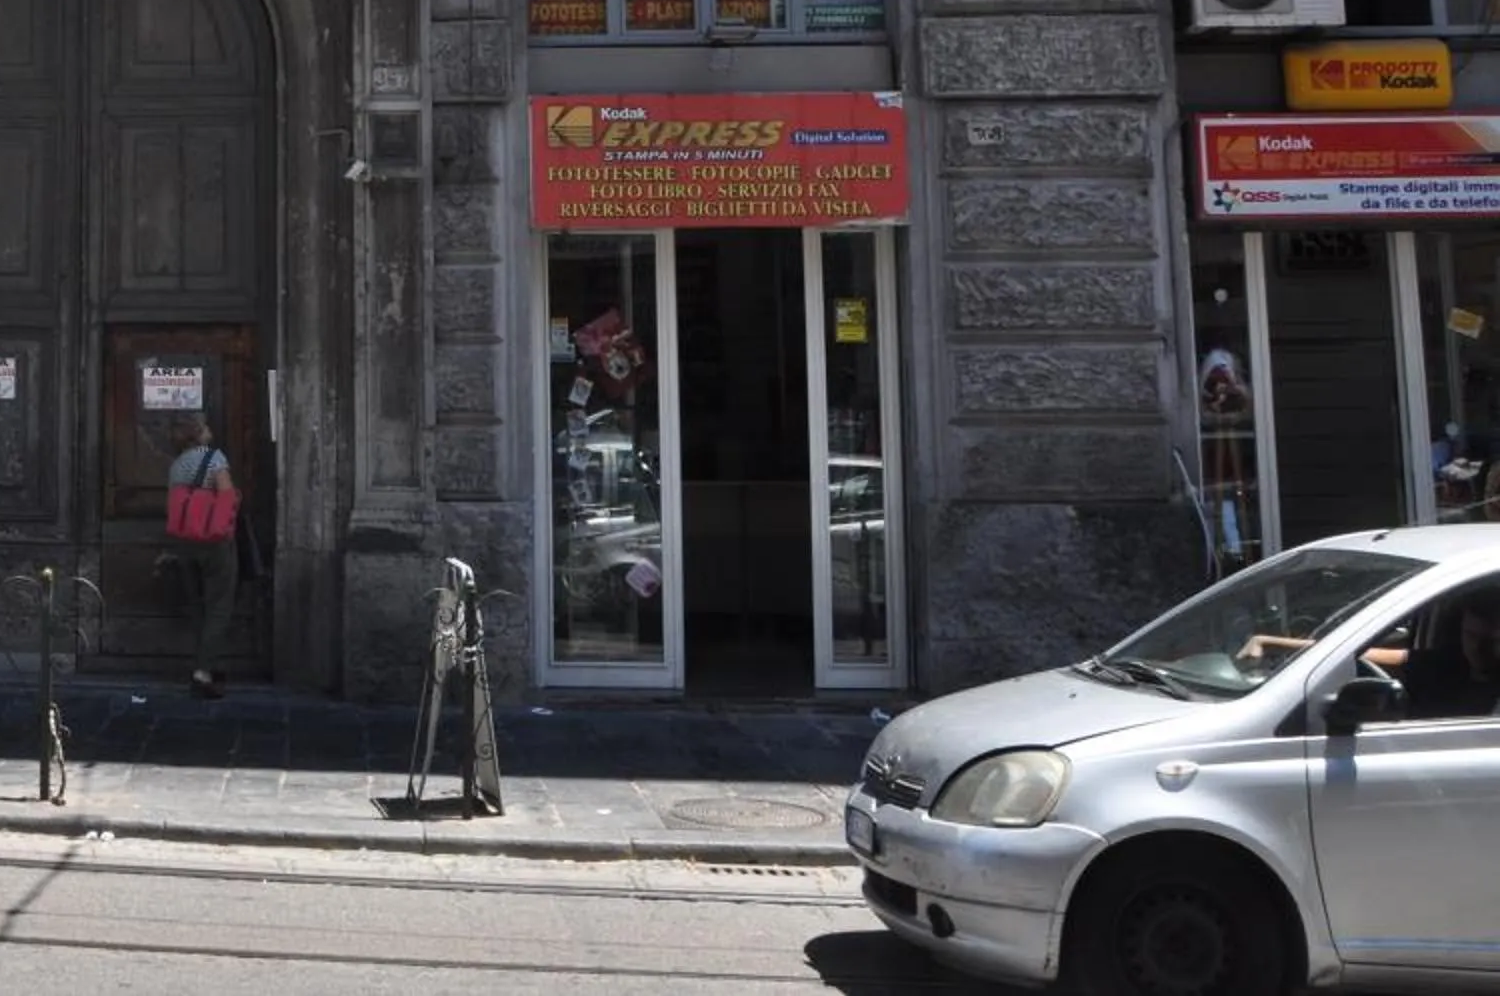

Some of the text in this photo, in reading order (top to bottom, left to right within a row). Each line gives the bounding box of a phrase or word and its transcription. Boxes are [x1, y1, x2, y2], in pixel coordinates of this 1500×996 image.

[1349, 60, 1439, 75] PRODOTTI
[1380, 74, 1440, 89] Kodak
[601, 107, 647, 120] Kodak
[602, 120, 885, 147] EXPRESS Digital Solution
[1258, 134, 1313, 151] Kodak
[603, 151, 669, 161] STAMPA
[672, 150, 689, 160] IN
[707, 149, 764, 160] MINUTI
[1288, 150, 1396, 171] EXPRESS
[548, 164, 893, 182] FOTOTESSERE FOTOCOPIE GADGET
[590, 182, 841, 199] FOTO LIBRO SERVIZIO FAX
[1339, 182, 1400, 195] Stampe
[1403, 180, 1459, 195] digitali
[560, 200, 872, 217] RIVERSAGGI BIGLIETTI DA VISITA
[1360, 198, 1381, 209] da
[1384, 197, 1411, 209] file
[1413, 198, 1425, 209] e
[1428, 197, 1449, 209] da
